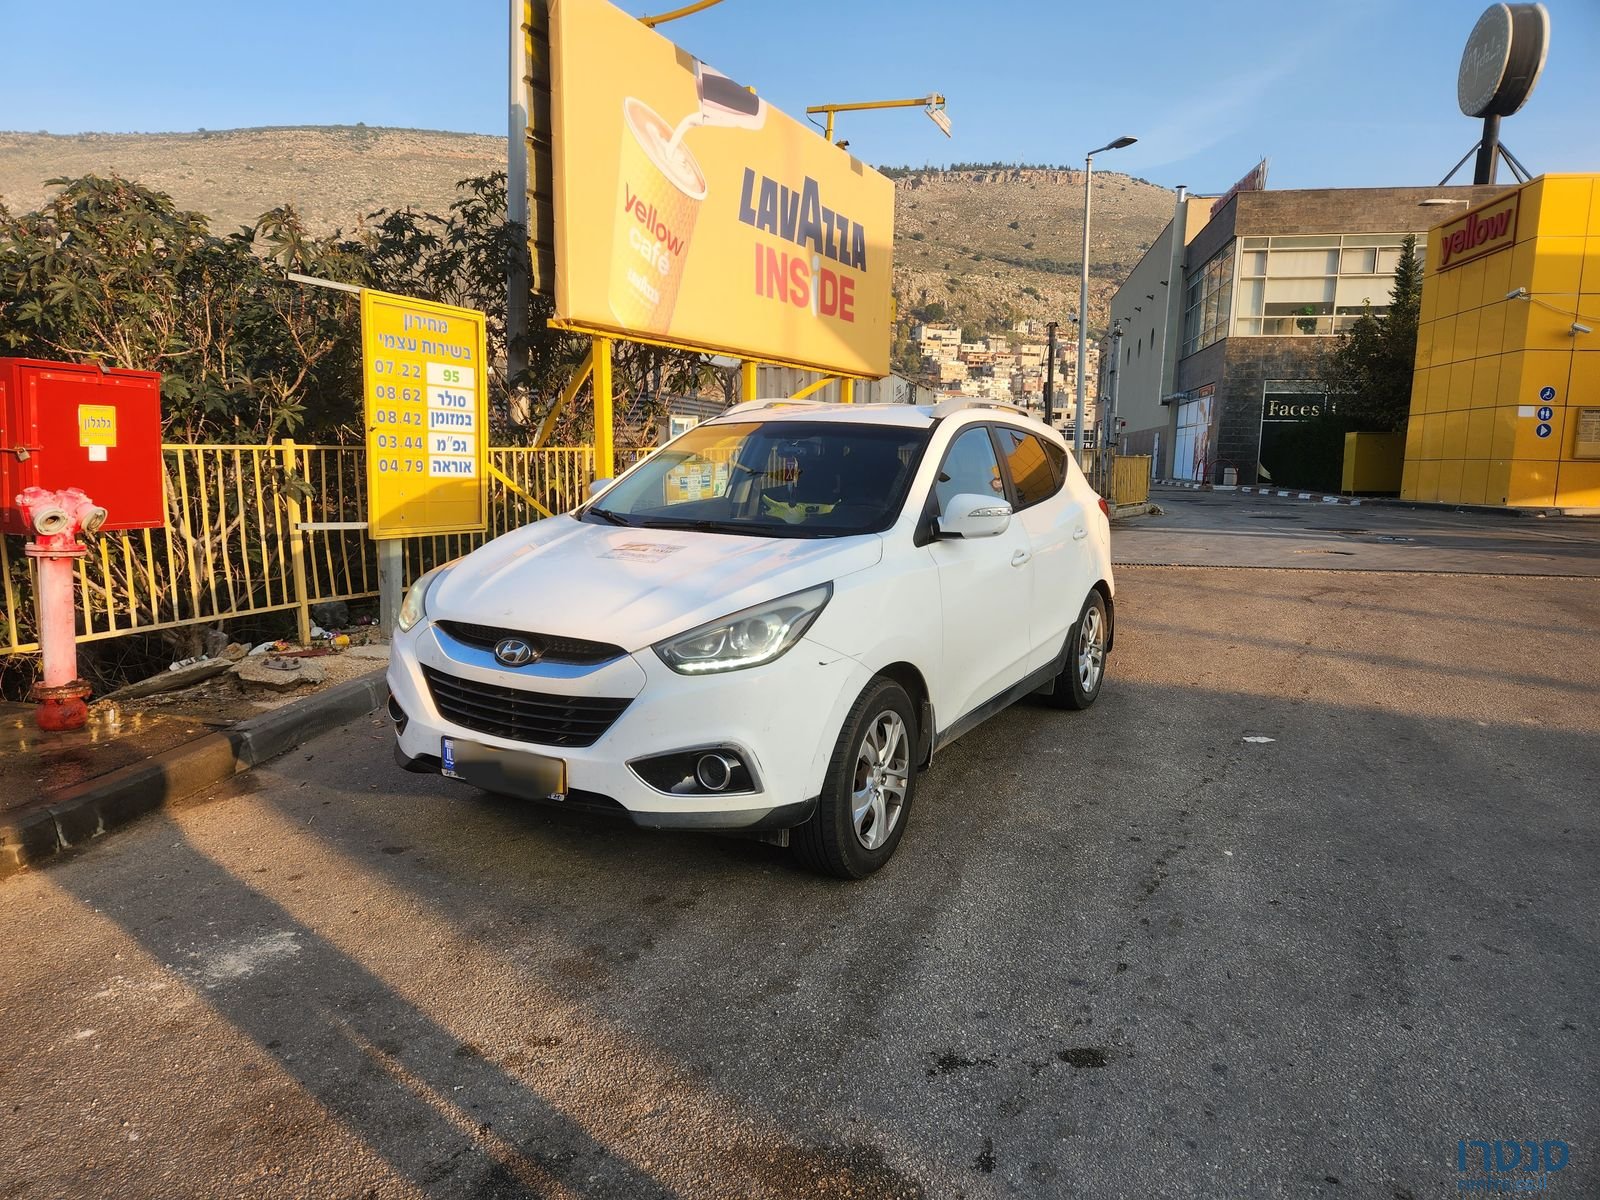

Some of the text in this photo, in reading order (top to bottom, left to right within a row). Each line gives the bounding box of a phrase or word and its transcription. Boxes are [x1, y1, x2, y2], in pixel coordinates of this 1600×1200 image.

[624, 181, 684, 256] yellow
[739, 167, 867, 272] LAVAZZA
[1442, 208, 1512, 265] yellow
[404, 313, 448, 334] מחירון
[378, 333, 472, 360] בשירות עצמי
[374, 359, 460, 383] 95 07.22
[376, 385, 467, 408] סולר 08.62
[376, 410, 472, 428] במזומן 08.42
[1268, 400, 1321, 417] Faces
[84, 415, 111, 431] גלגלון
[378, 434, 423, 449] 03.44
[379, 459, 472, 474] אוראה 04.79
